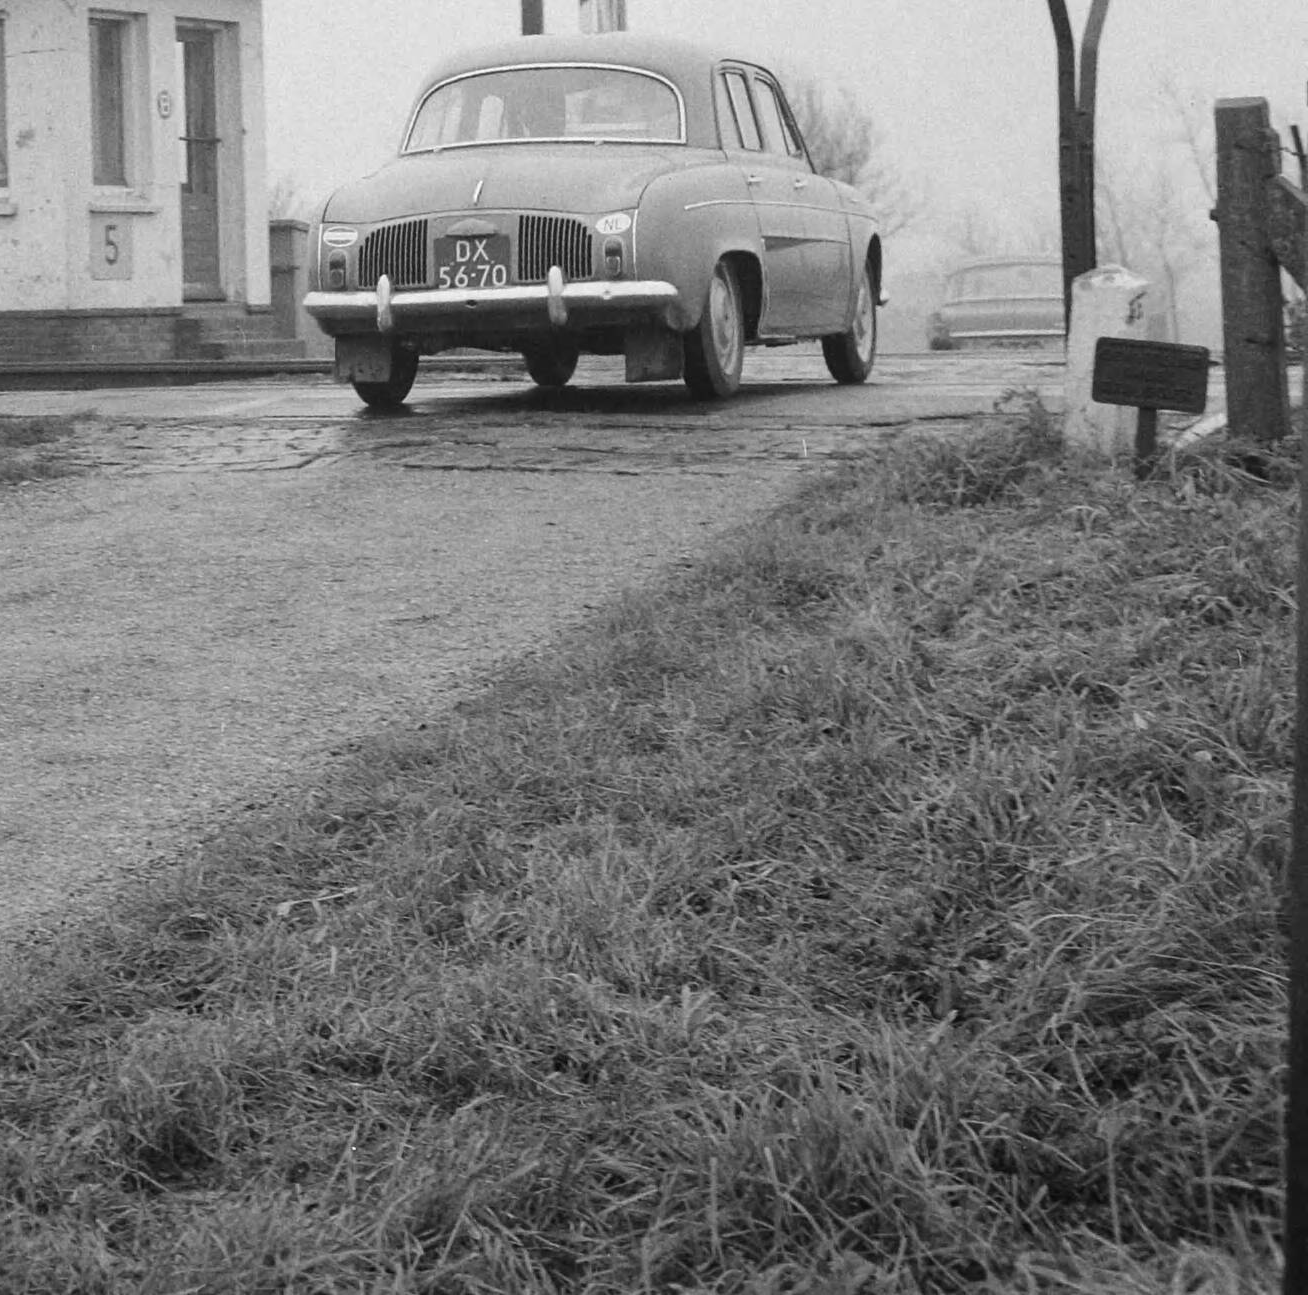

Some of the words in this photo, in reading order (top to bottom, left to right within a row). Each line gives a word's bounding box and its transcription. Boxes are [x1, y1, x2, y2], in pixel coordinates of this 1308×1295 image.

[603, 218, 623, 231] NL
[104, 224, 119, 266] 5
[456, 239, 489, 262] DX
[439, 264, 507, 289] 56-70
